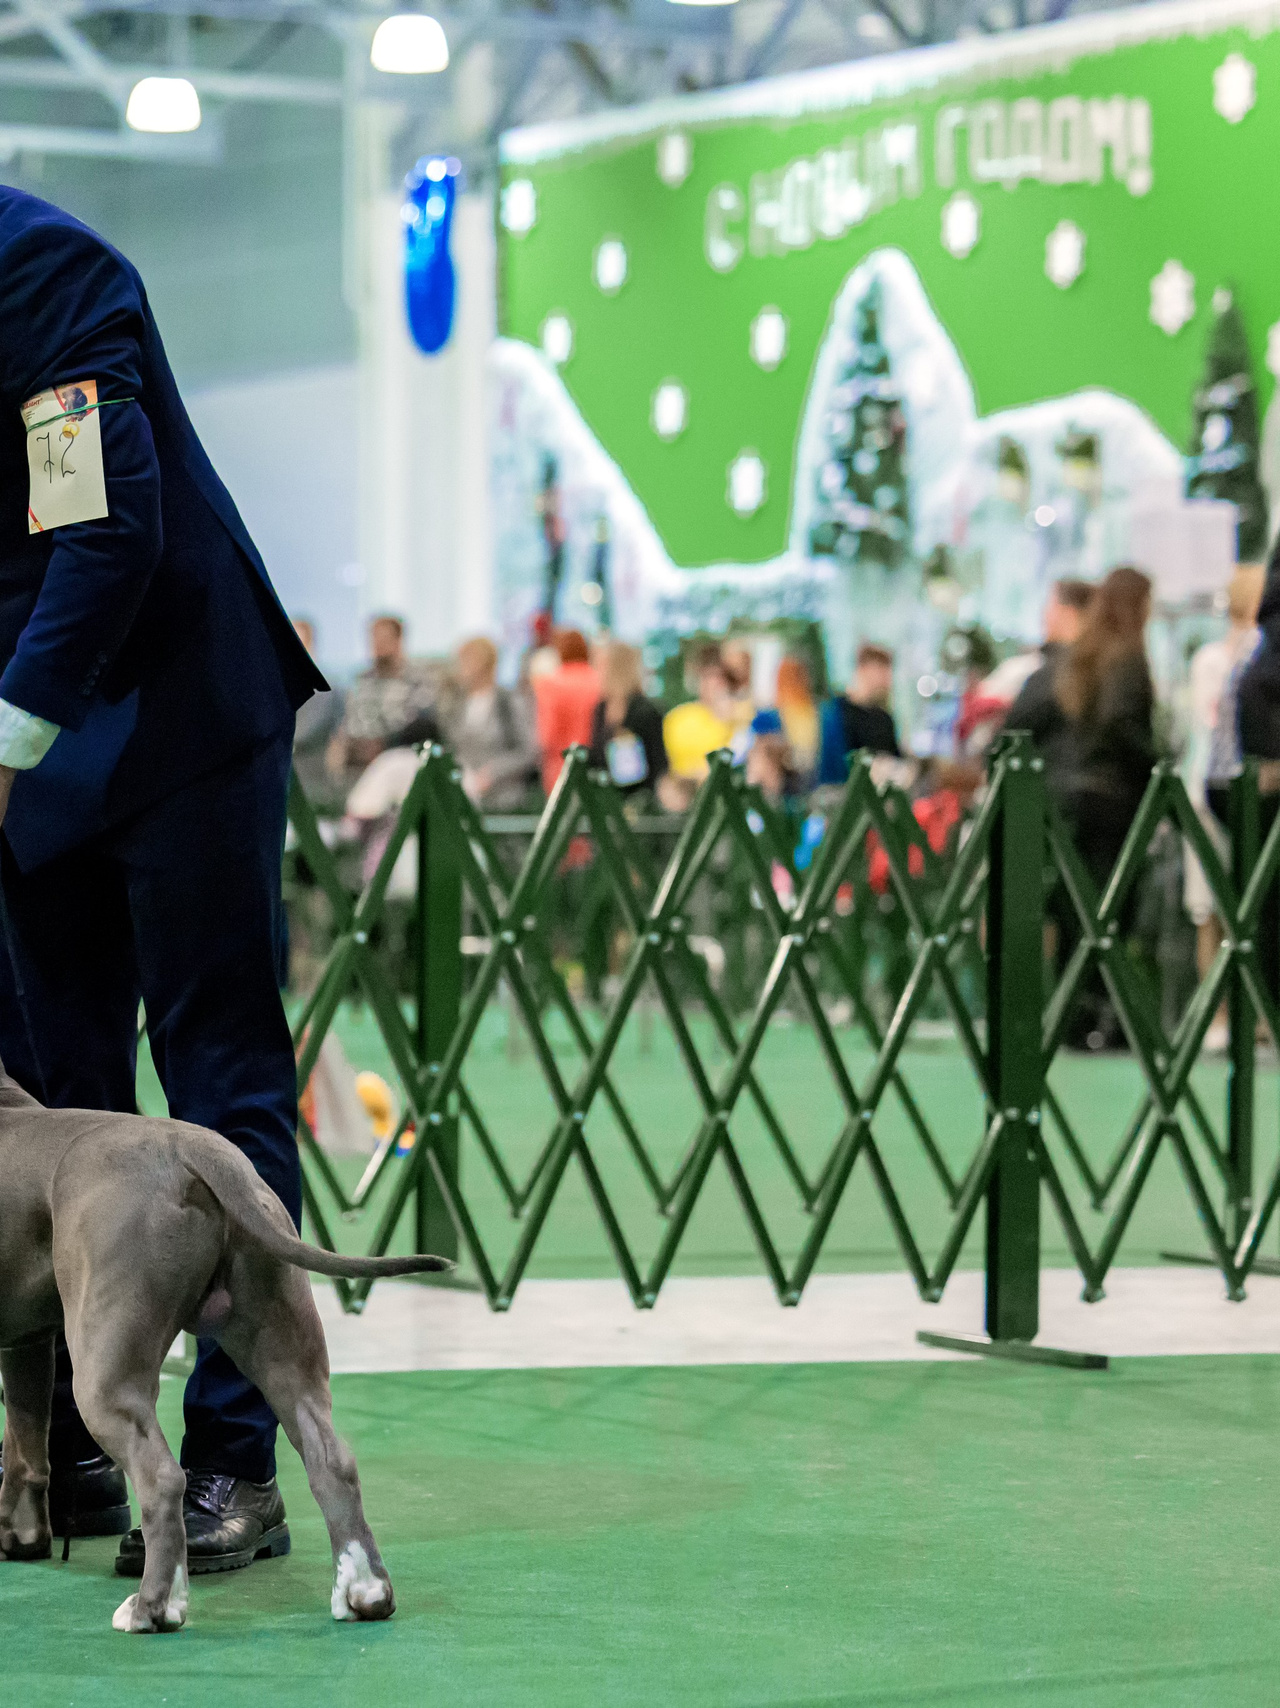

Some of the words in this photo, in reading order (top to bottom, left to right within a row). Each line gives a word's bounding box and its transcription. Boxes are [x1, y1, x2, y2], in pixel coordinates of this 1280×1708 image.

[706, 184, 743, 272] С
[936, 96, 1150, 195] ГОДОМ!
[36, 431, 77, 484] 72
